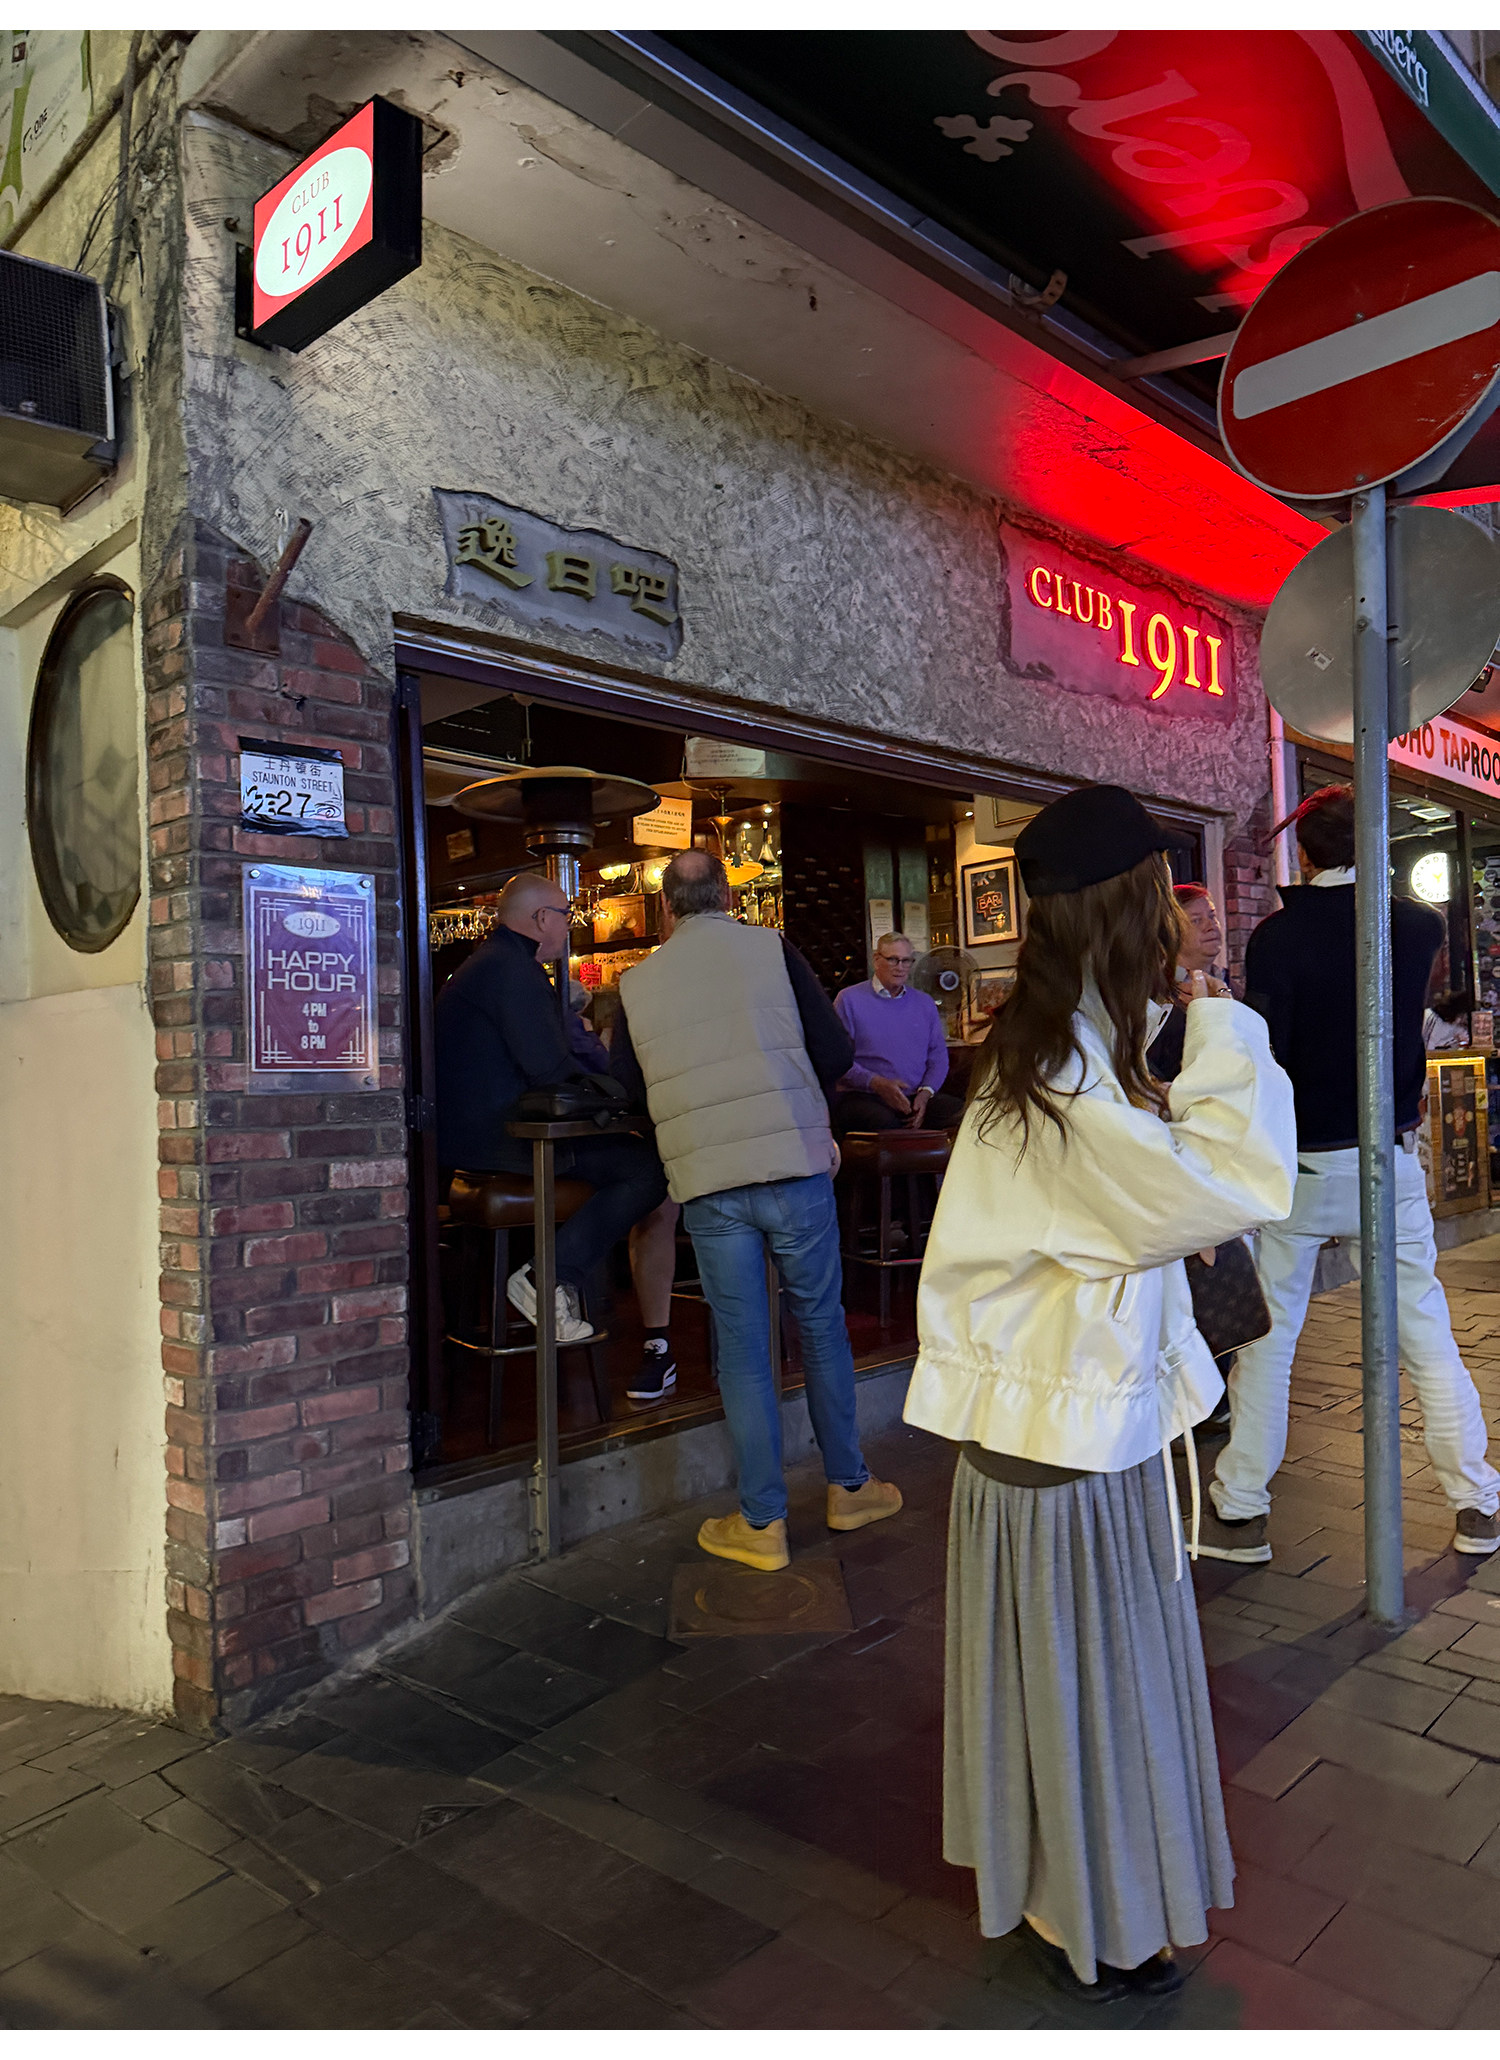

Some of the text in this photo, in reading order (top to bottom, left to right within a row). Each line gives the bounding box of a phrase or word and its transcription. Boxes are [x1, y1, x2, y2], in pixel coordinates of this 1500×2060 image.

[291, 171, 330, 214] CLUB
[281, 193, 343, 275] 1911
[455, 517, 679, 627] 逸日吧
[1031, 566, 1224, 701] CLUB 1911
[264, 757, 322, 777] 士丹頓街
[252, 770, 334, 793] STAUNTON STREET
[978, 894, 1000, 911] BAR
[298, 917, 326, 936] 1911
[267, 949, 355, 973] HAPPY
[267, 970, 357, 993] HOUR
[302, 1002, 328, 1018] 4 PM
[307, 1019, 320, 1034] to
[300, 1035, 327, 1050] 8 PM
